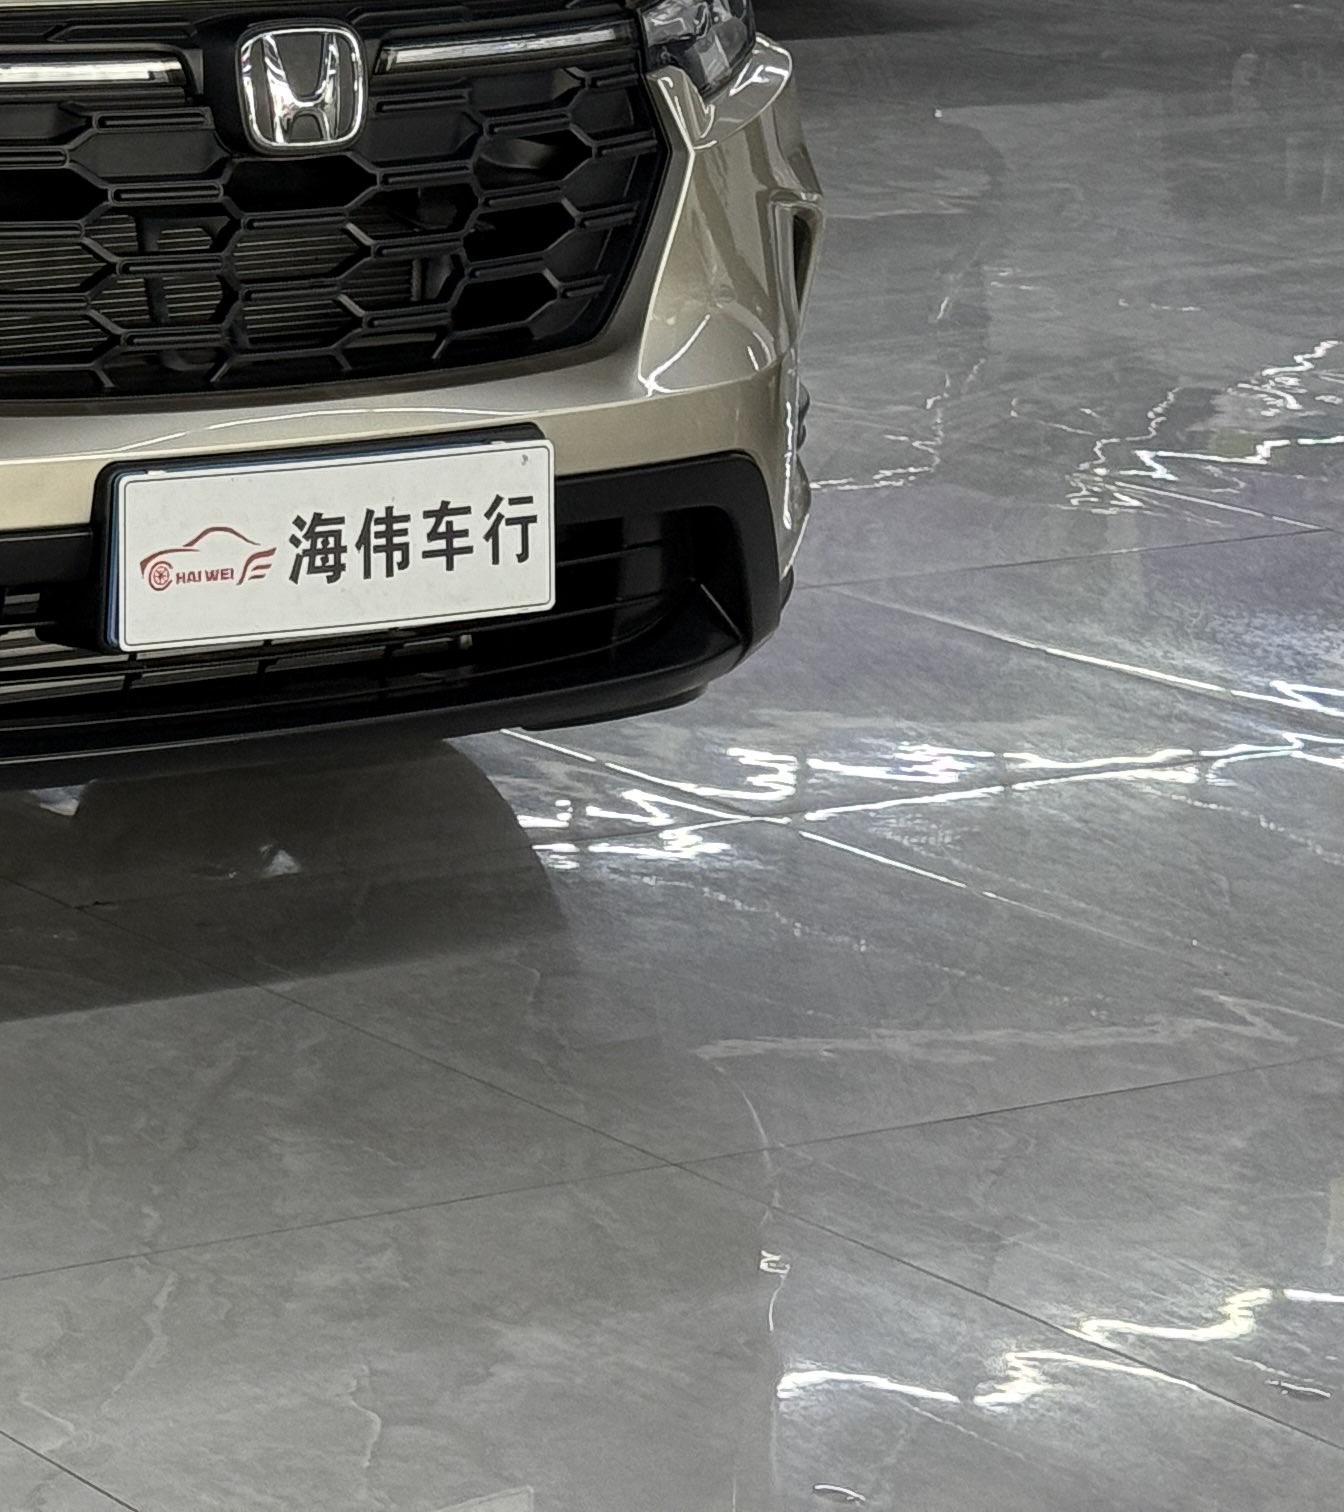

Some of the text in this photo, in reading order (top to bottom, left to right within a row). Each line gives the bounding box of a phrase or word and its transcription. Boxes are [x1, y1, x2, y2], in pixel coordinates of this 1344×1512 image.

[288, 494, 538, 585] 海伟车行
[175, 567, 234, 585] HAI WEI
